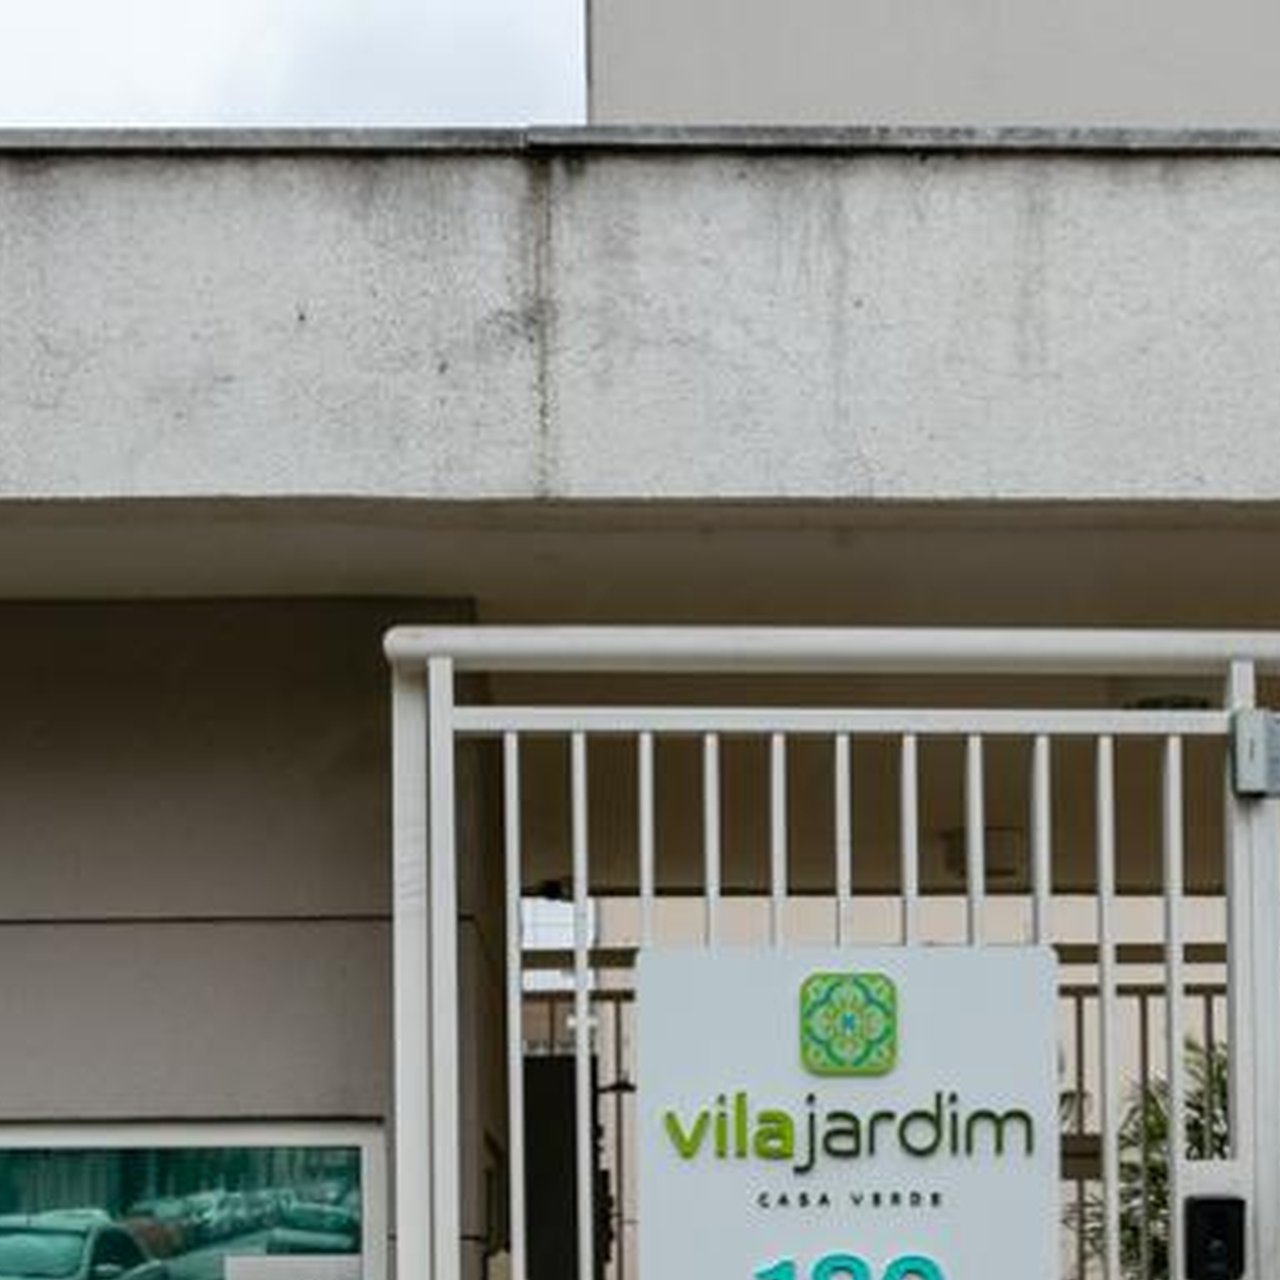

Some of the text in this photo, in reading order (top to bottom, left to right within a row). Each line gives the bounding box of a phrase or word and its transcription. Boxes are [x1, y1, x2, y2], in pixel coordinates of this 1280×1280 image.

[662, 1092, 1034, 1174] vilajardim
[757, 1191, 941, 1208] CASA VERDE
